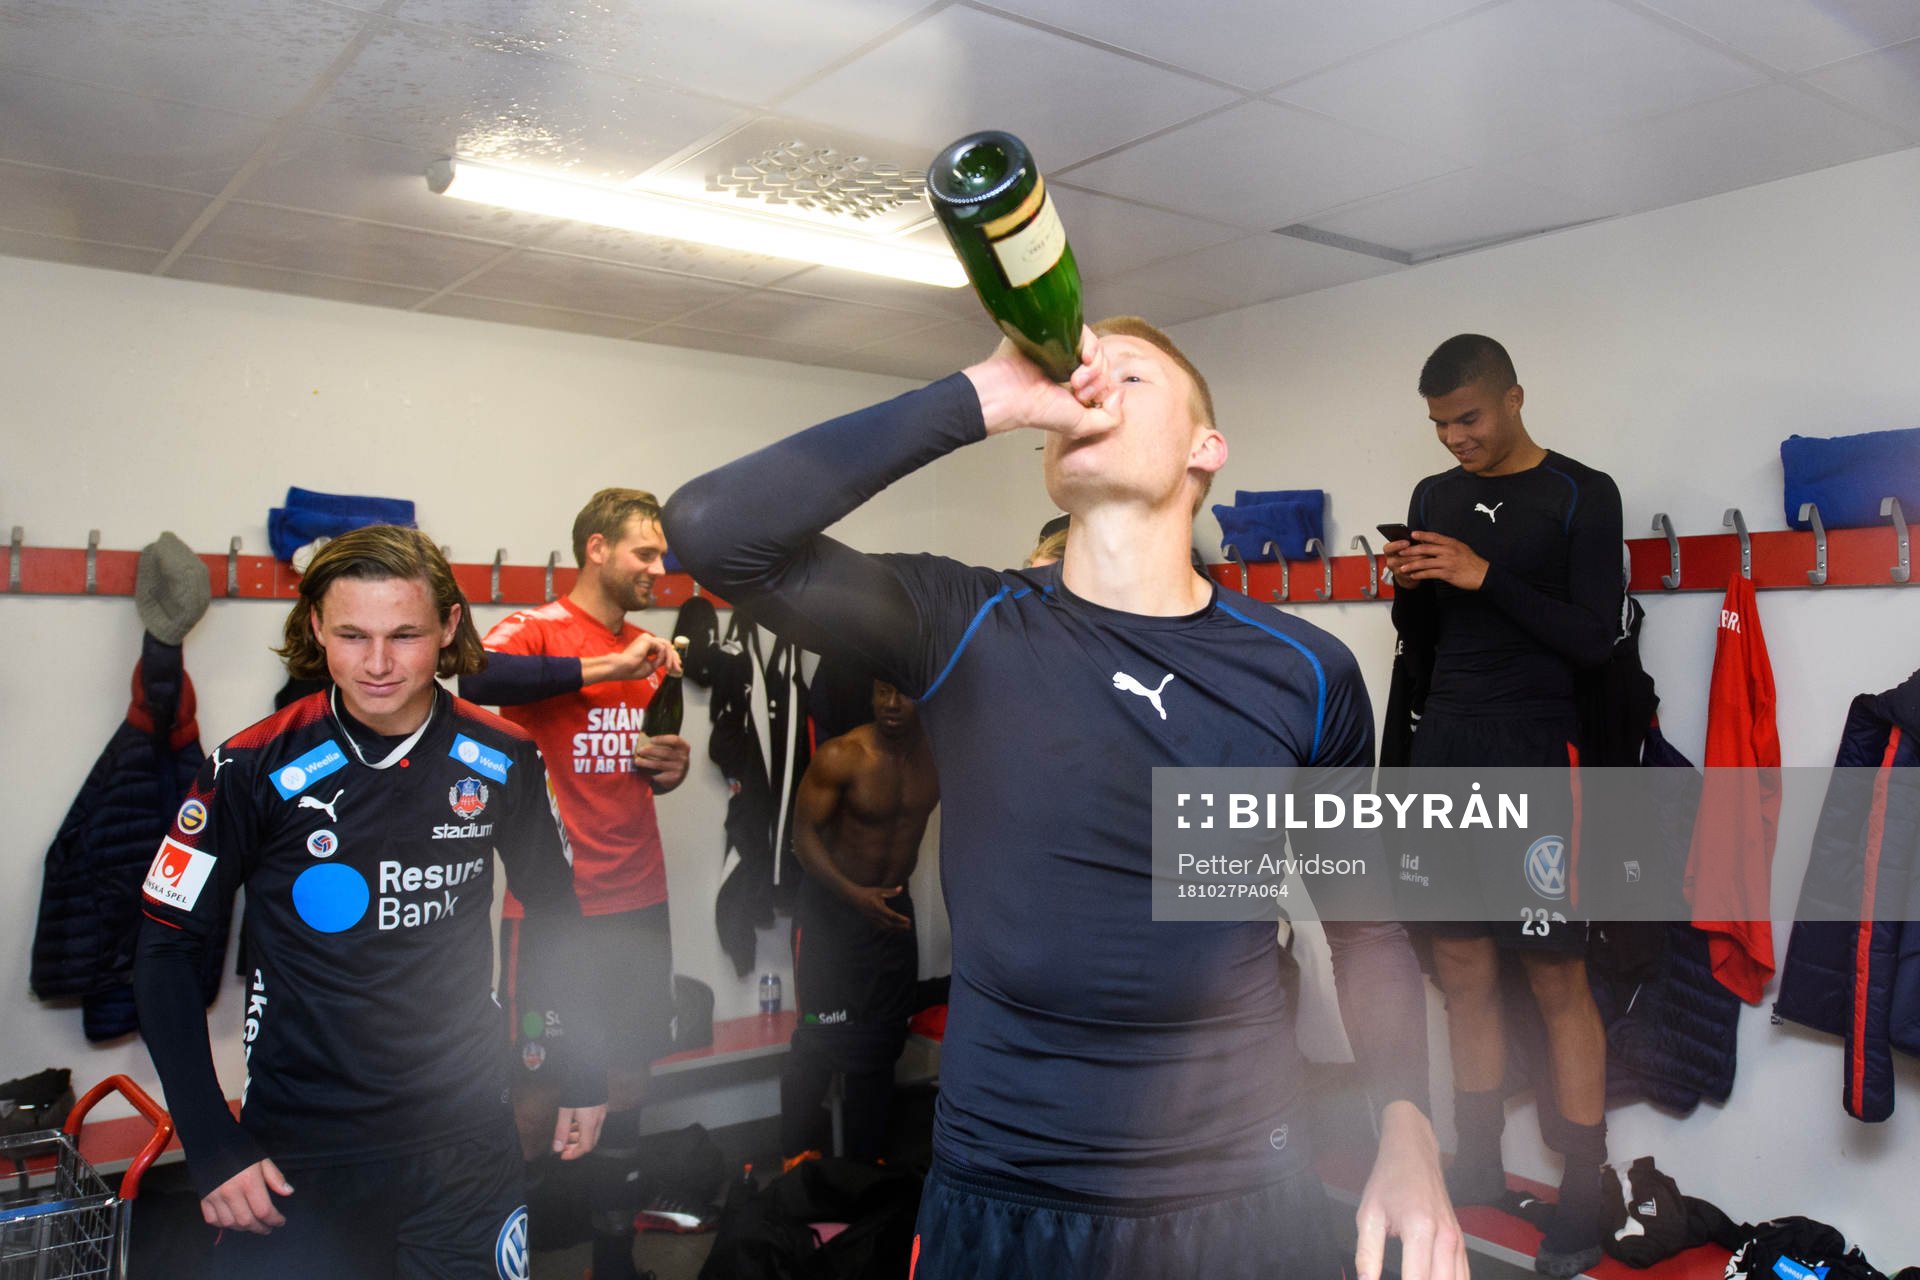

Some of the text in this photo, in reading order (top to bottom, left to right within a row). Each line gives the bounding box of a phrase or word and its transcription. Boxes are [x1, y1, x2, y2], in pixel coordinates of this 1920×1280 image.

[587, 701, 645, 732] SKÅN
[572, 732, 640, 757] STOLT
[573, 755, 637, 774] VI ÄR TI
[432, 823, 494, 839] stadium
[1401, 853, 1419, 870] lid
[379, 857, 484, 894] Resurs
[145, 878, 189, 904] NSKA SPEL
[378, 890, 459, 931] Bank
[1520, 906, 1551, 937] 23
[818, 1009, 847, 1024] Solid
